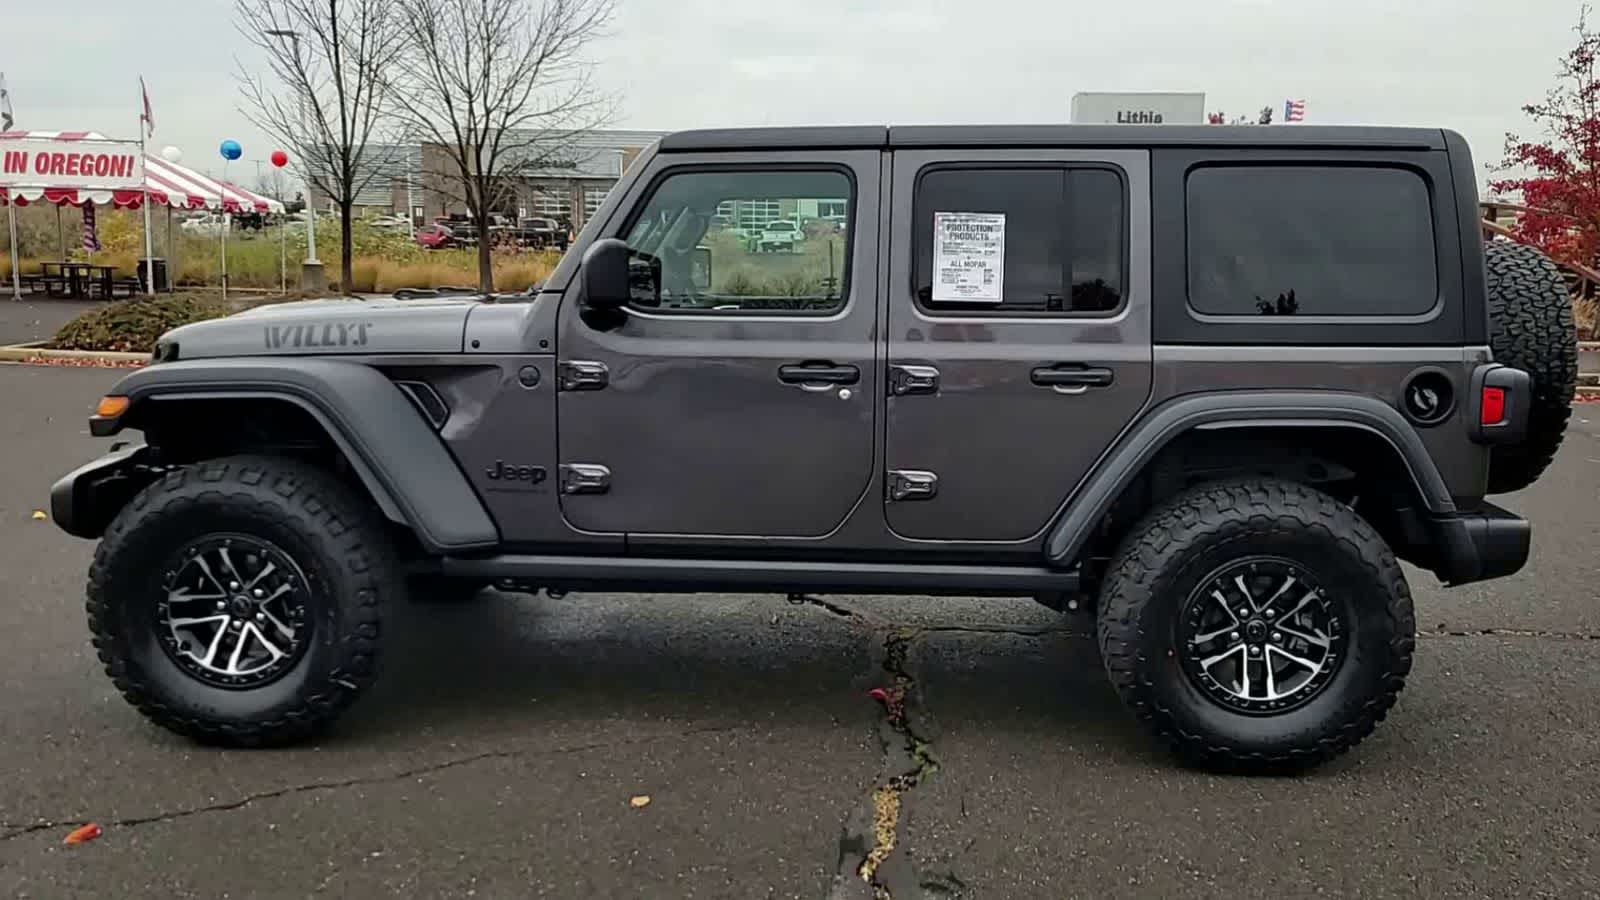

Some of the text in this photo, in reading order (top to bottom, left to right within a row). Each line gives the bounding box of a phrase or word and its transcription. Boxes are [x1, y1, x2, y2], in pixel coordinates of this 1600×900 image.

[1117, 110, 1163, 124] Lithia
[3, 151, 135, 177] IN OREGON!
[946, 223, 993, 233] PROTECTION
[949, 232, 989, 241] PRODUCTS
[950, 260, 987, 268] ALL MOPAR
[485, 458, 547, 485] Jeep
